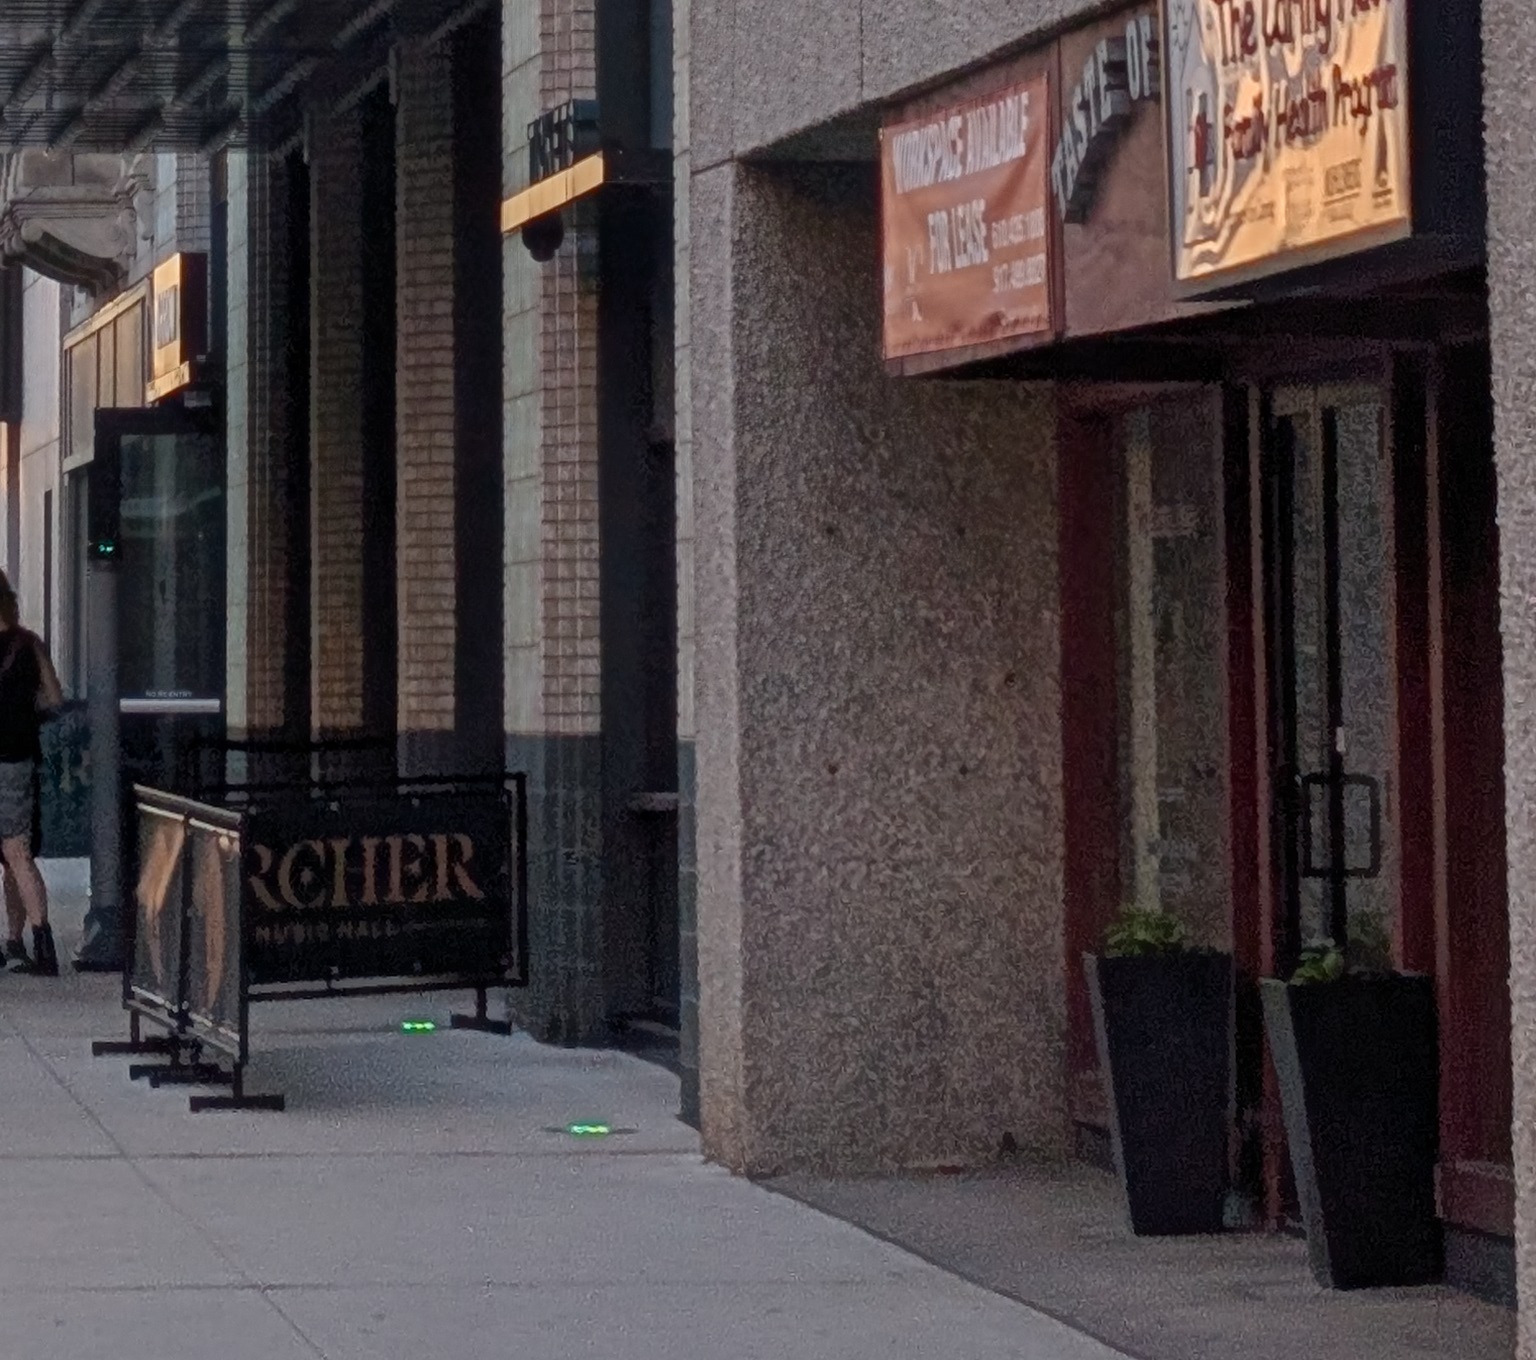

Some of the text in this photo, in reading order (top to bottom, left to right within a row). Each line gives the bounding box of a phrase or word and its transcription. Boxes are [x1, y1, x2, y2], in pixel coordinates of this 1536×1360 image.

[1125, 15, 1156, 101] OF
[927, 209, 952, 274] FOR
[951, 197, 989, 269] LEASE
[248, 833, 486, 910] RCHER
